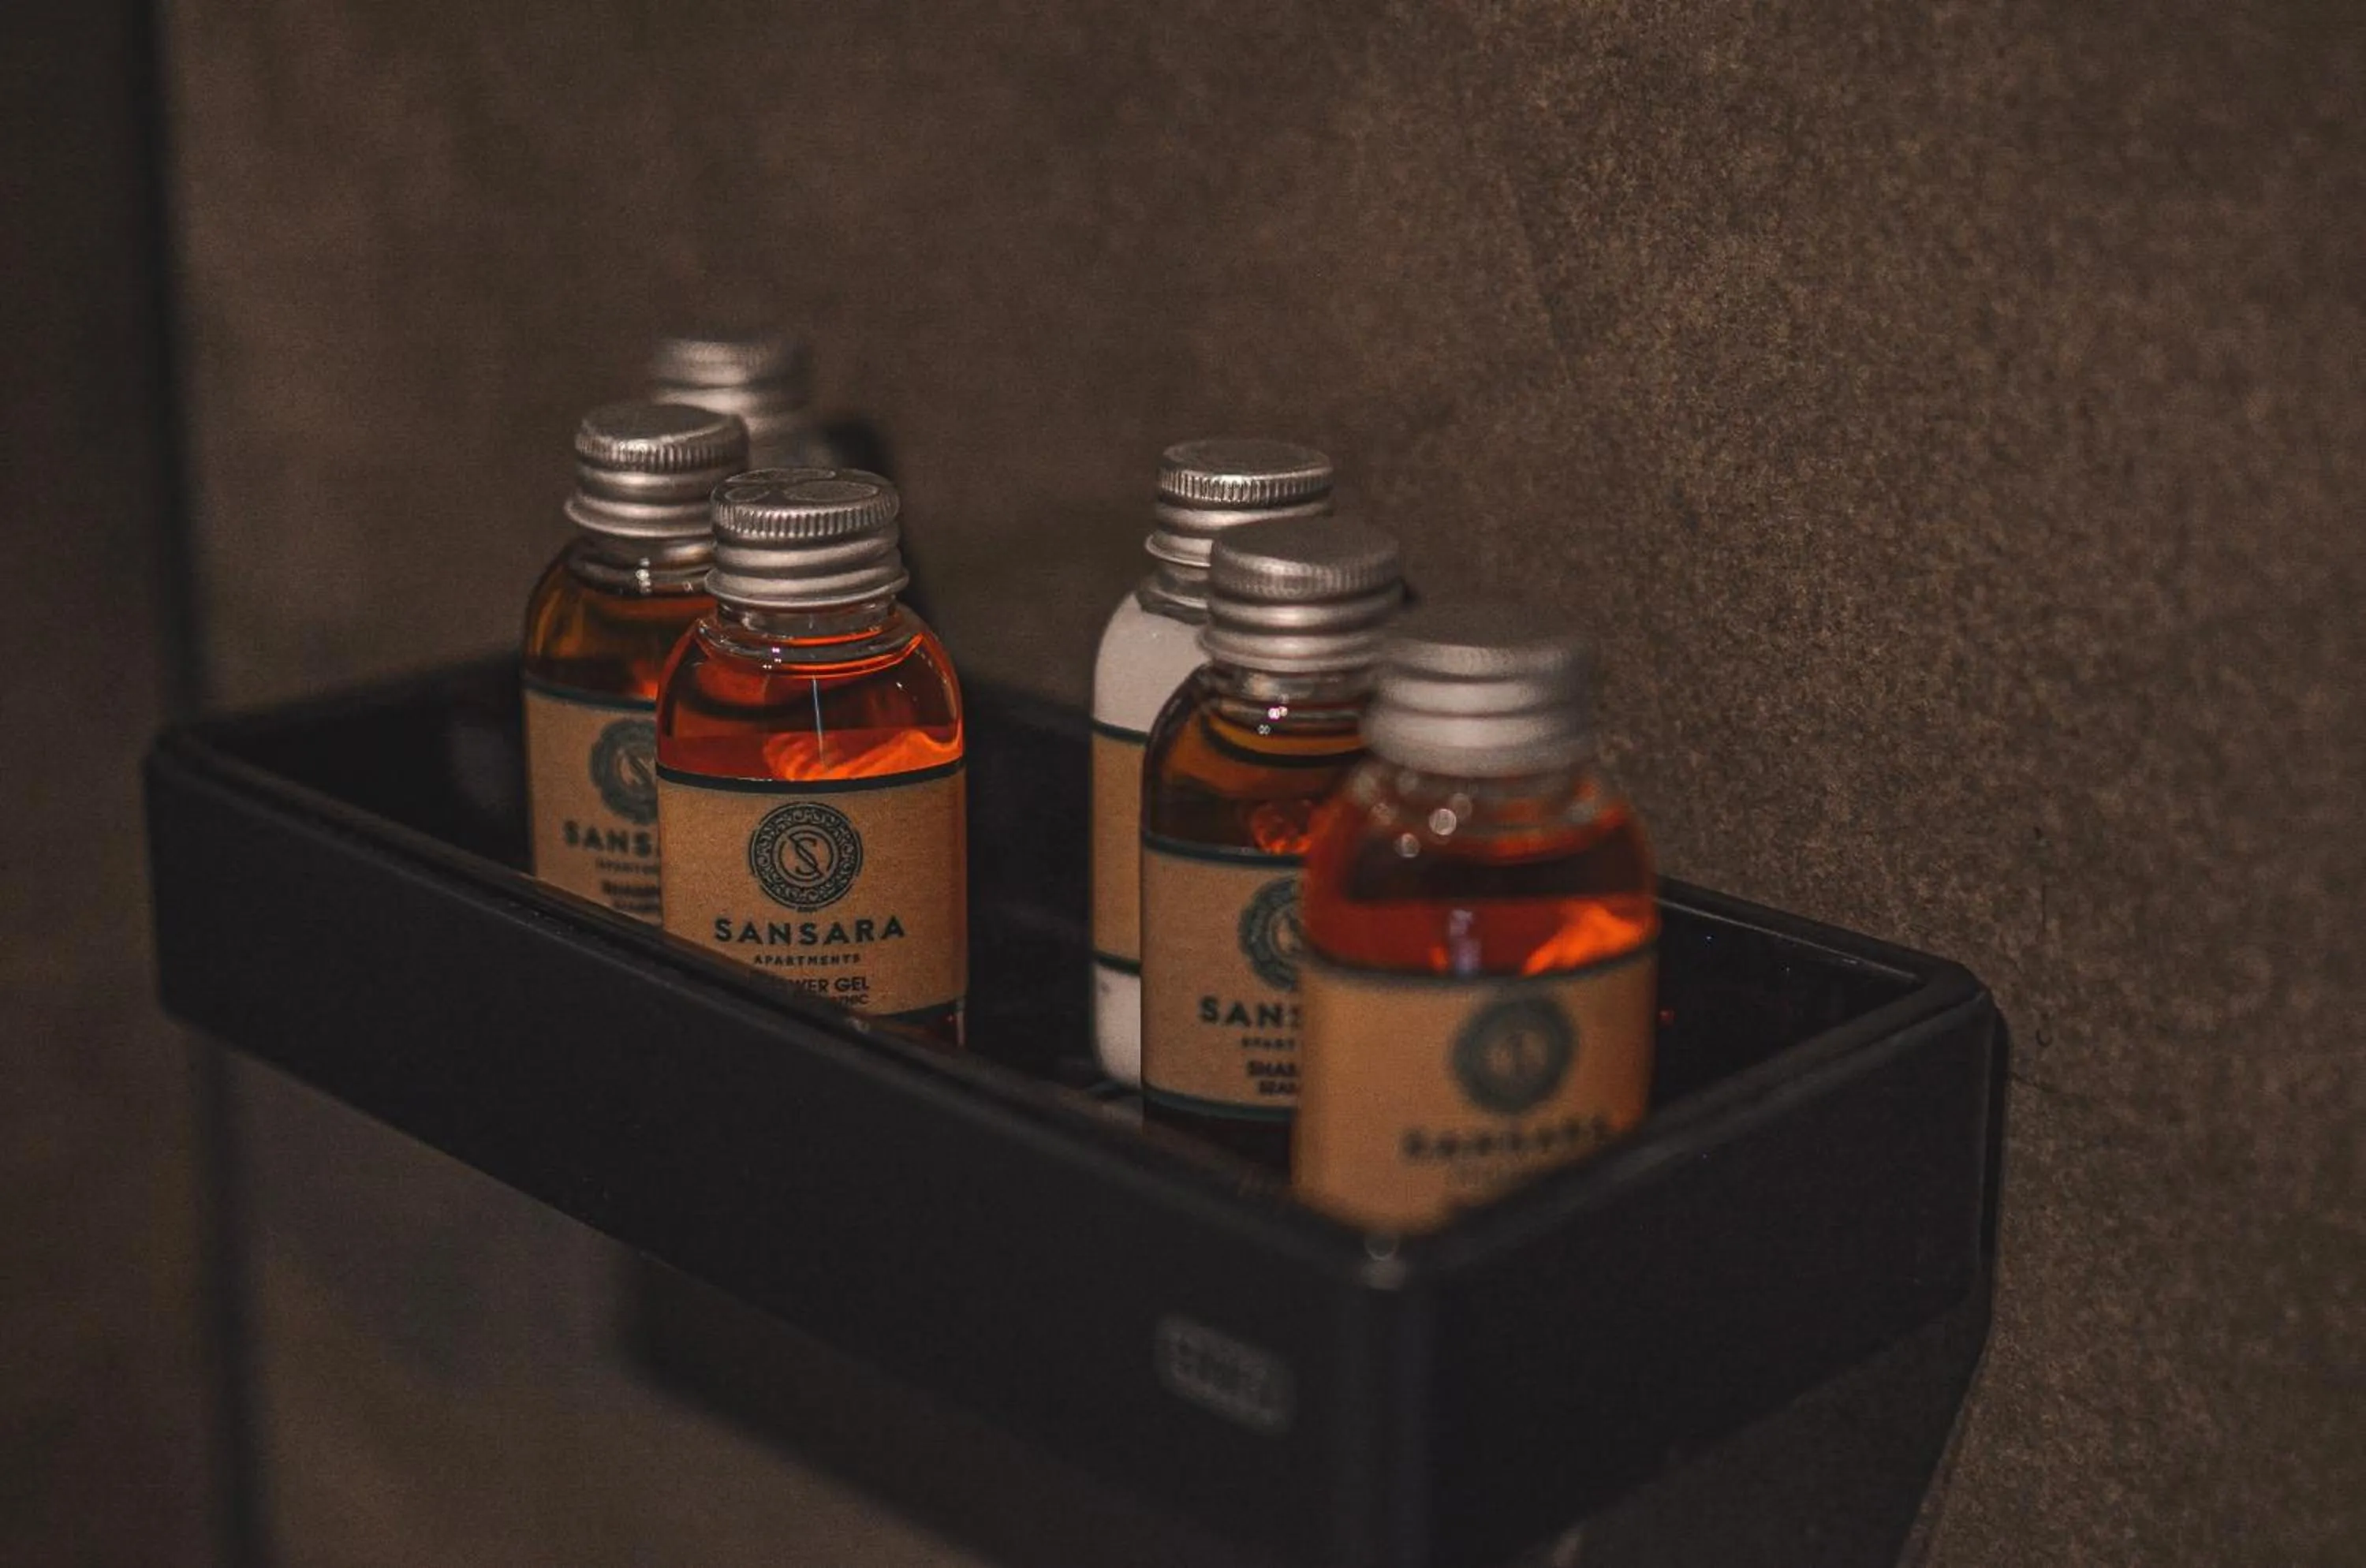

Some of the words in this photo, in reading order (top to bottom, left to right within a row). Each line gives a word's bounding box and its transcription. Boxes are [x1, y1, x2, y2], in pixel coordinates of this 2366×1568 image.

[563, 820, 656, 858] SANS
[715, 915, 905, 946] SANSARA
[754, 953, 861, 966] APARTMENTS
[834, 976, 870, 992] GEL
[1200, 995, 1302, 1030] SANS
